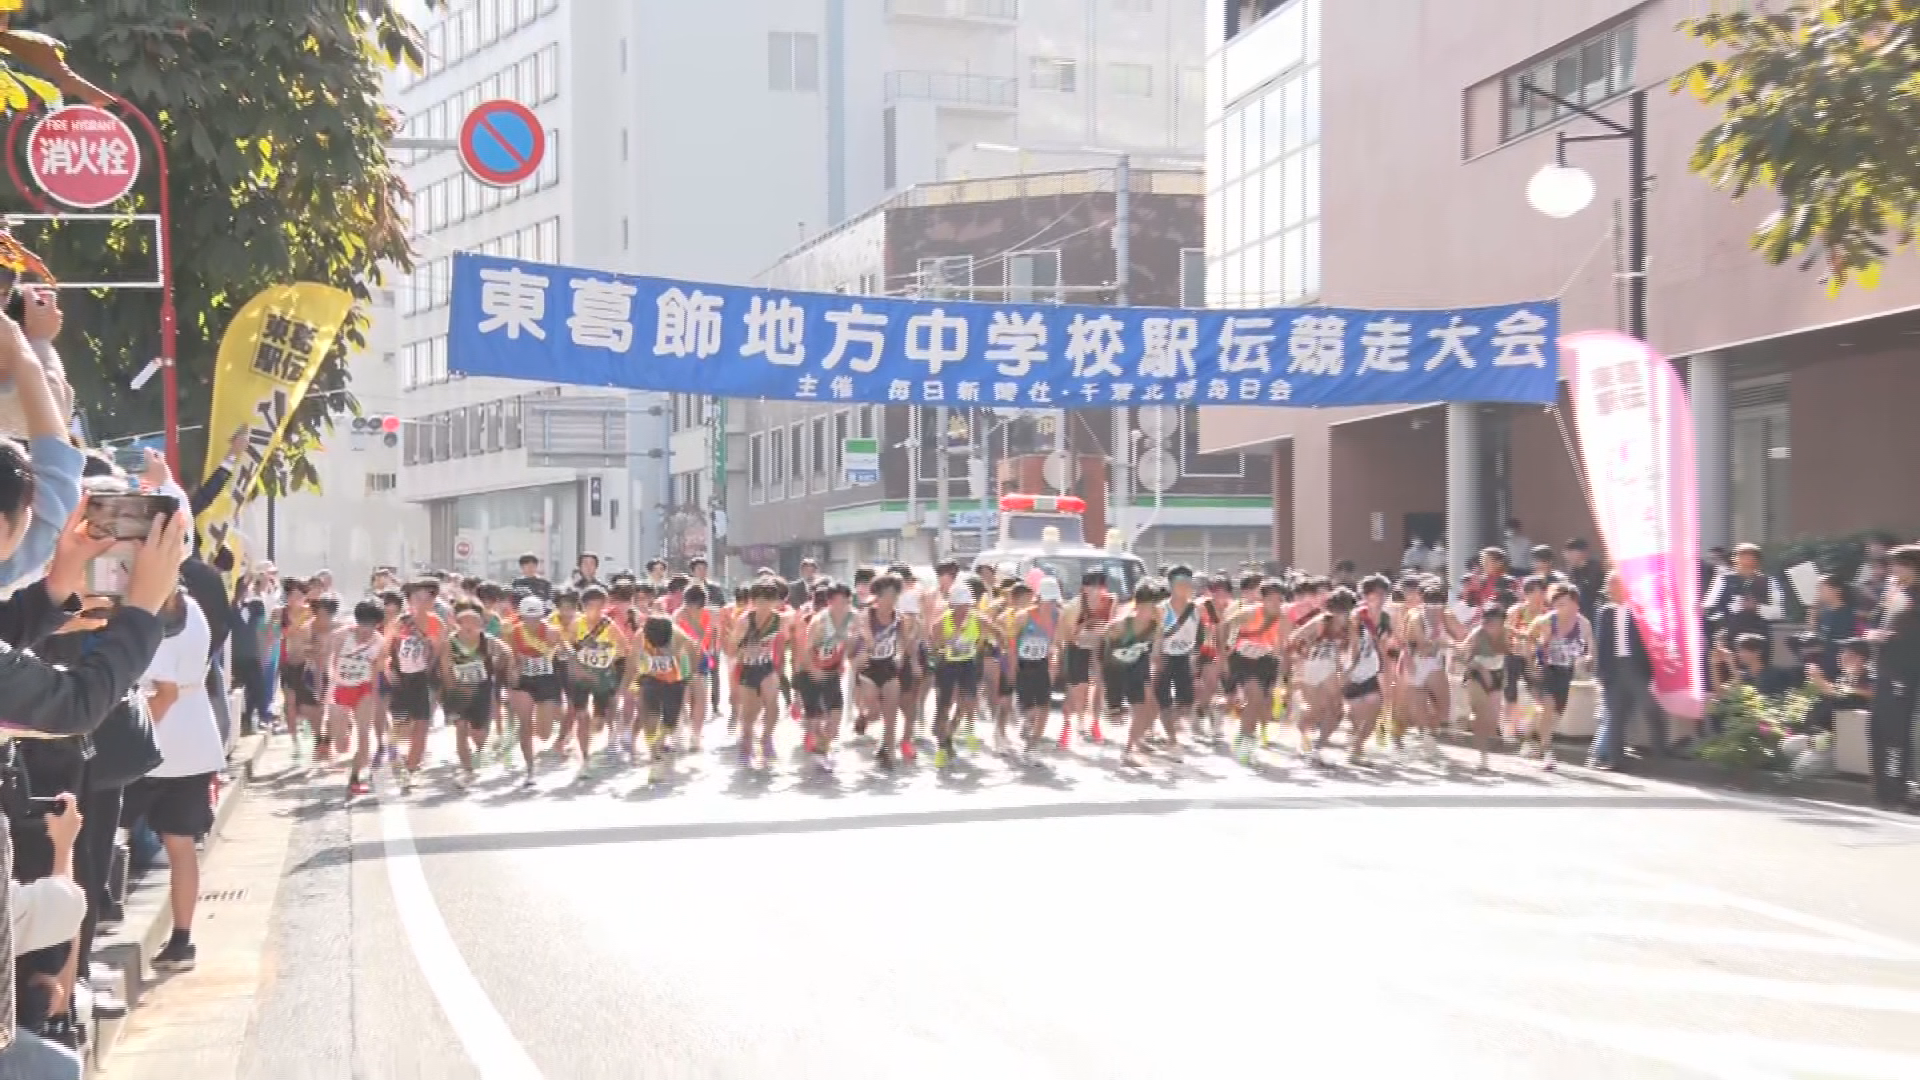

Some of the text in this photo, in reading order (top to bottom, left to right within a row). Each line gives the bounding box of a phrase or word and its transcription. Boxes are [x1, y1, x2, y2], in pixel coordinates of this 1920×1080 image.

[45, 119, 68, 131] FIRE
[39, 137, 129, 175] 消火栓
[261, 313, 319, 355] 東葛
[478, 267, 1549, 377] 東葛飾地方中学校駅伝競走大会
[253, 342, 310, 382] 駅伝
